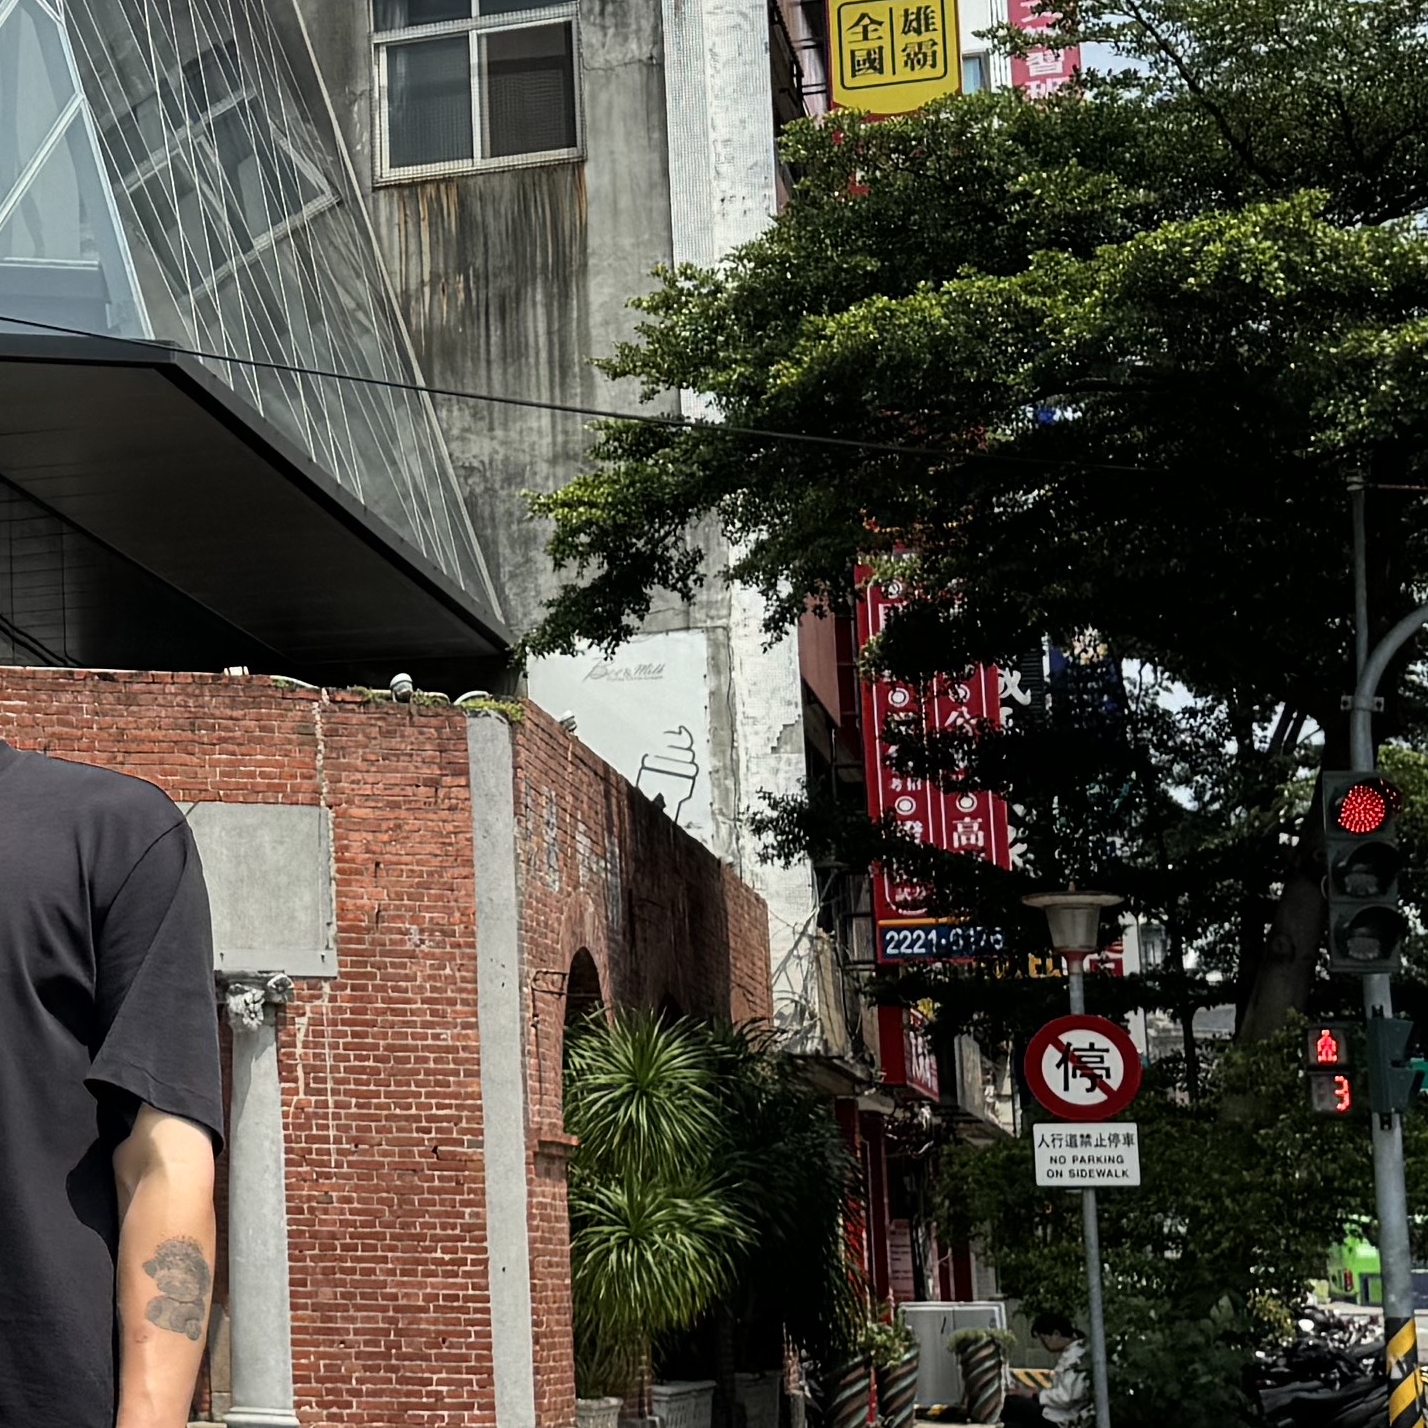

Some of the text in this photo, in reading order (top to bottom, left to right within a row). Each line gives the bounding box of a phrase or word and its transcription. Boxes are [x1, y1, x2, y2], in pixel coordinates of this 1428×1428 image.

[846, 12, 885, 79] 全國
[900, 4, 940, 72] 雄霸
[1055, 1041, 1111, 1093] 停
[1334, 1075, 1350, 1111] 3
[1037, 1131, 1136, 1149] 人行道禁止停車
[1046, 1168, 1130, 1179] ON SIDEWALK
[1049, 1154, 1125, 1165] NO PARKING
